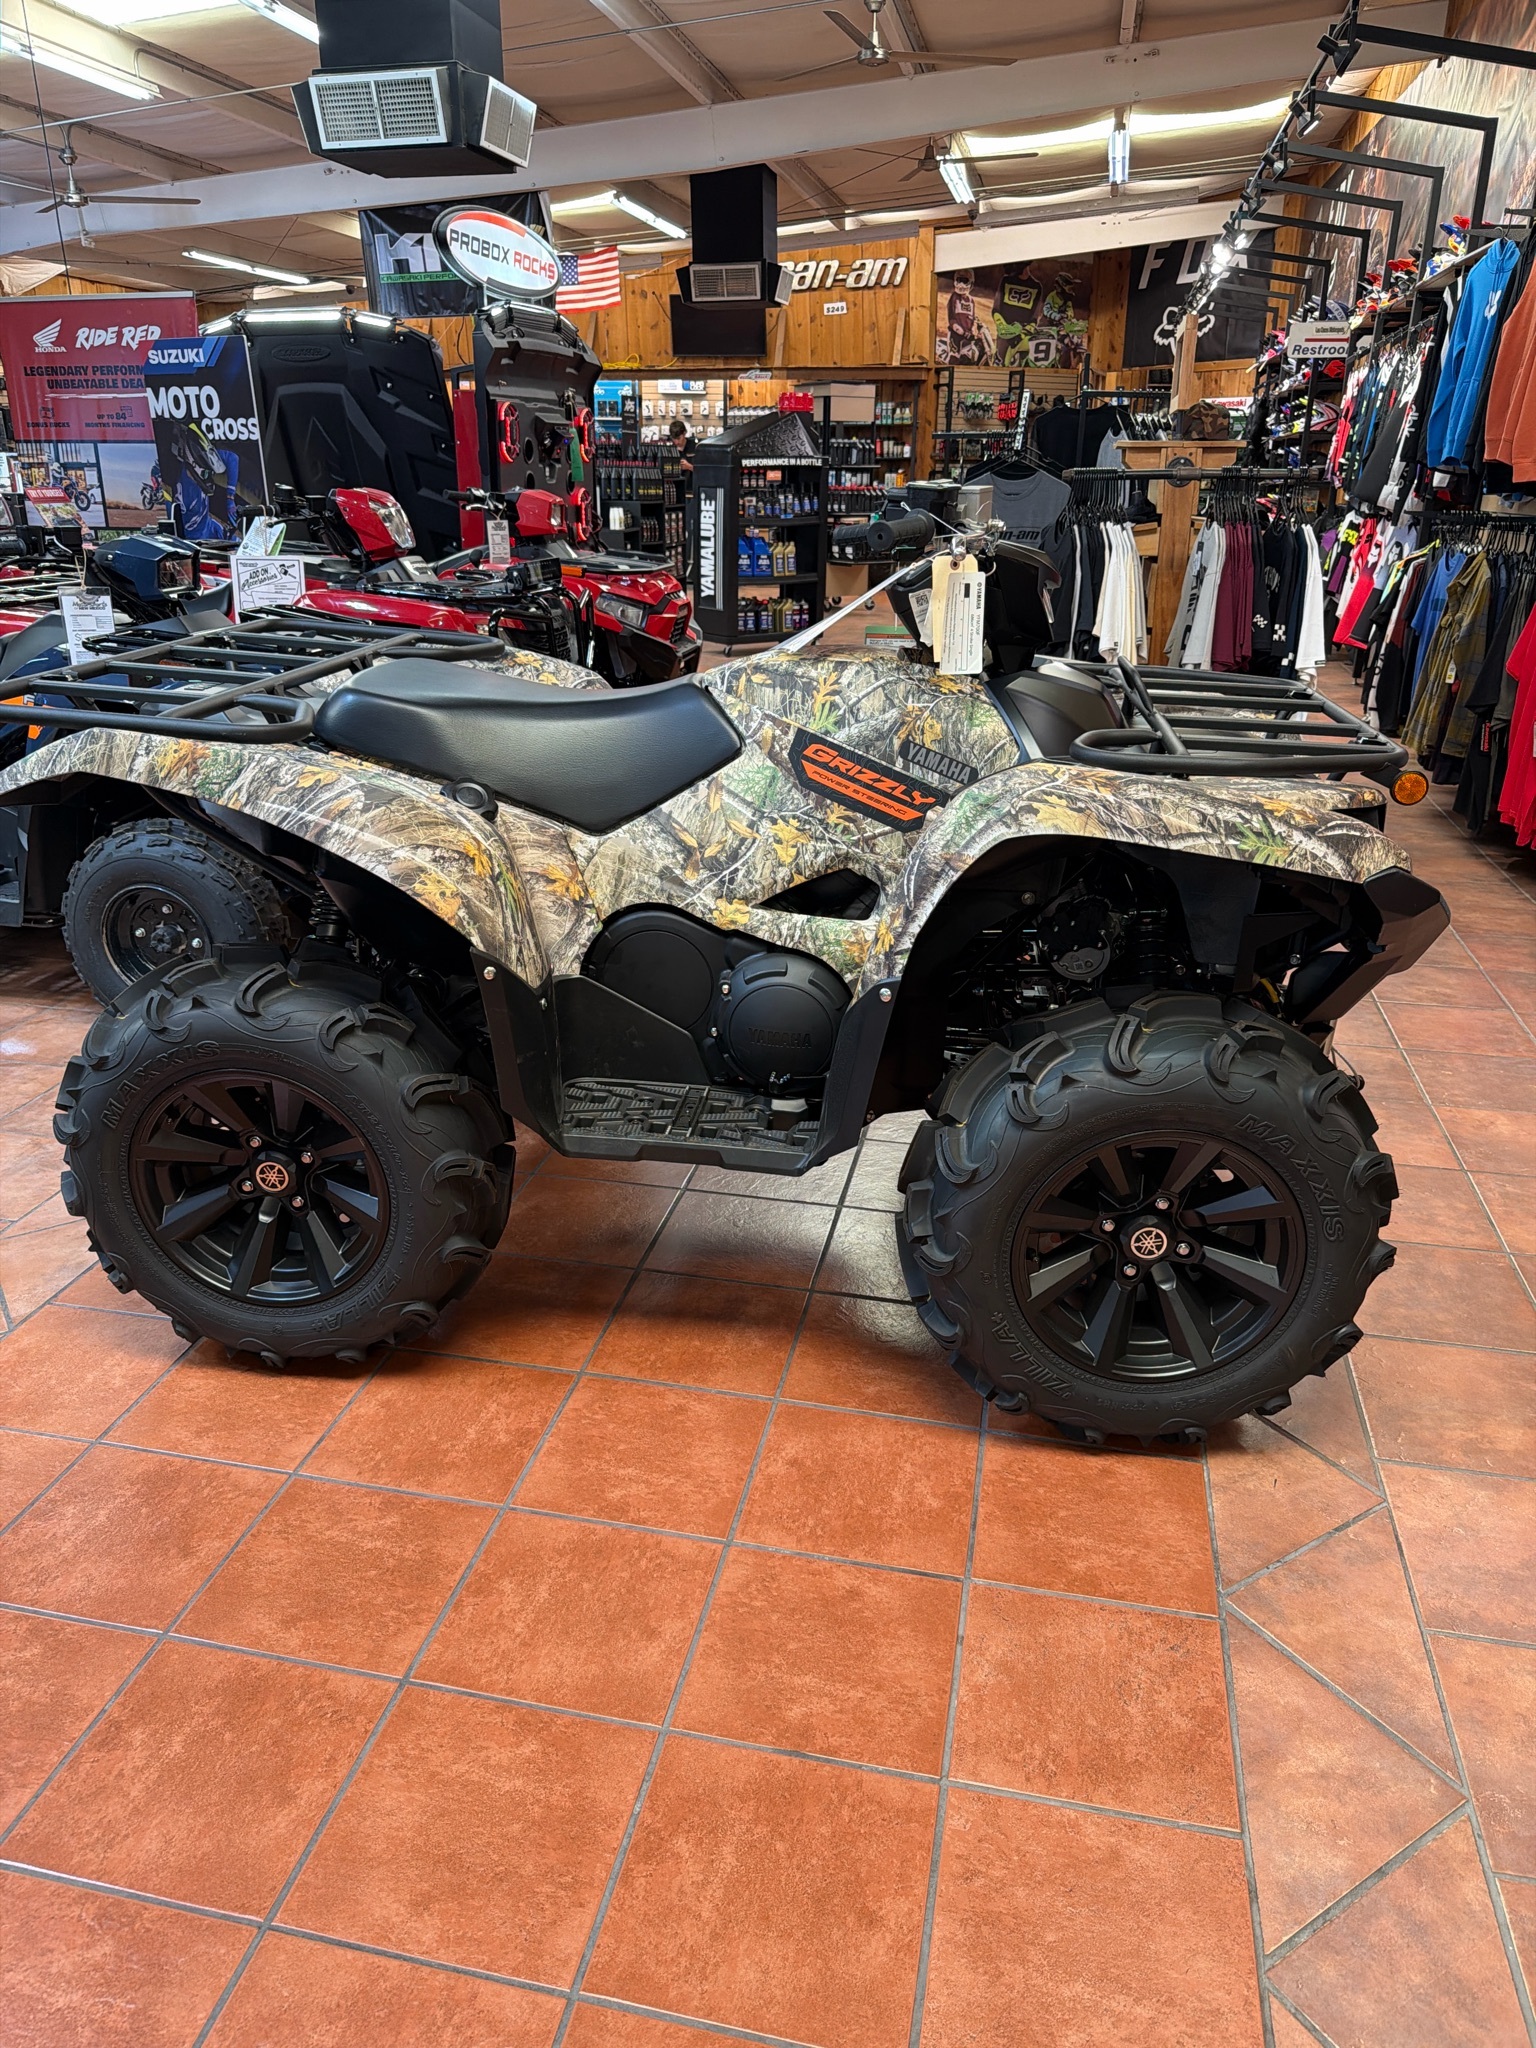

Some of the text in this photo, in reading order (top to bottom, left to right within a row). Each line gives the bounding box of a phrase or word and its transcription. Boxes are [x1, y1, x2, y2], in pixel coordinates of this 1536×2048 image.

[450, 228, 555, 280] PROBOX ROCKS
[826, 305, 845, 314] $249
[75, 324, 161, 350] RIDE RED
[147, 348, 205, 365] SUZUKI
[1034, 342, 1051, 363] 9
[1292, 344, 1368, 356] Restroos
[24, 365, 91, 377] LEGENDARY
[47, 378, 144, 389] UNBEATABLE DEA
[147, 385, 220, 419] MOTO
[1212, 399, 1247, 407] wasaki
[115, 412, 127, 420] 84
[201, 417, 259, 441] CROSS
[741, 458, 789, 467] PERFORMANCE
[802, 458, 822, 466] BOTTLE
[701, 499, 715, 598] YAMALUBE
[802, 743, 937, 806] GRIZZLY
[907, 742, 971, 785] YAMAHA
[812, 770, 908, 816] POWER STEERING
[748, 1027, 812, 1049] YAMAHA
[102, 1040, 220, 1129] MAXXIS
[1235, 1113, 1346, 1243] MAXXIS
